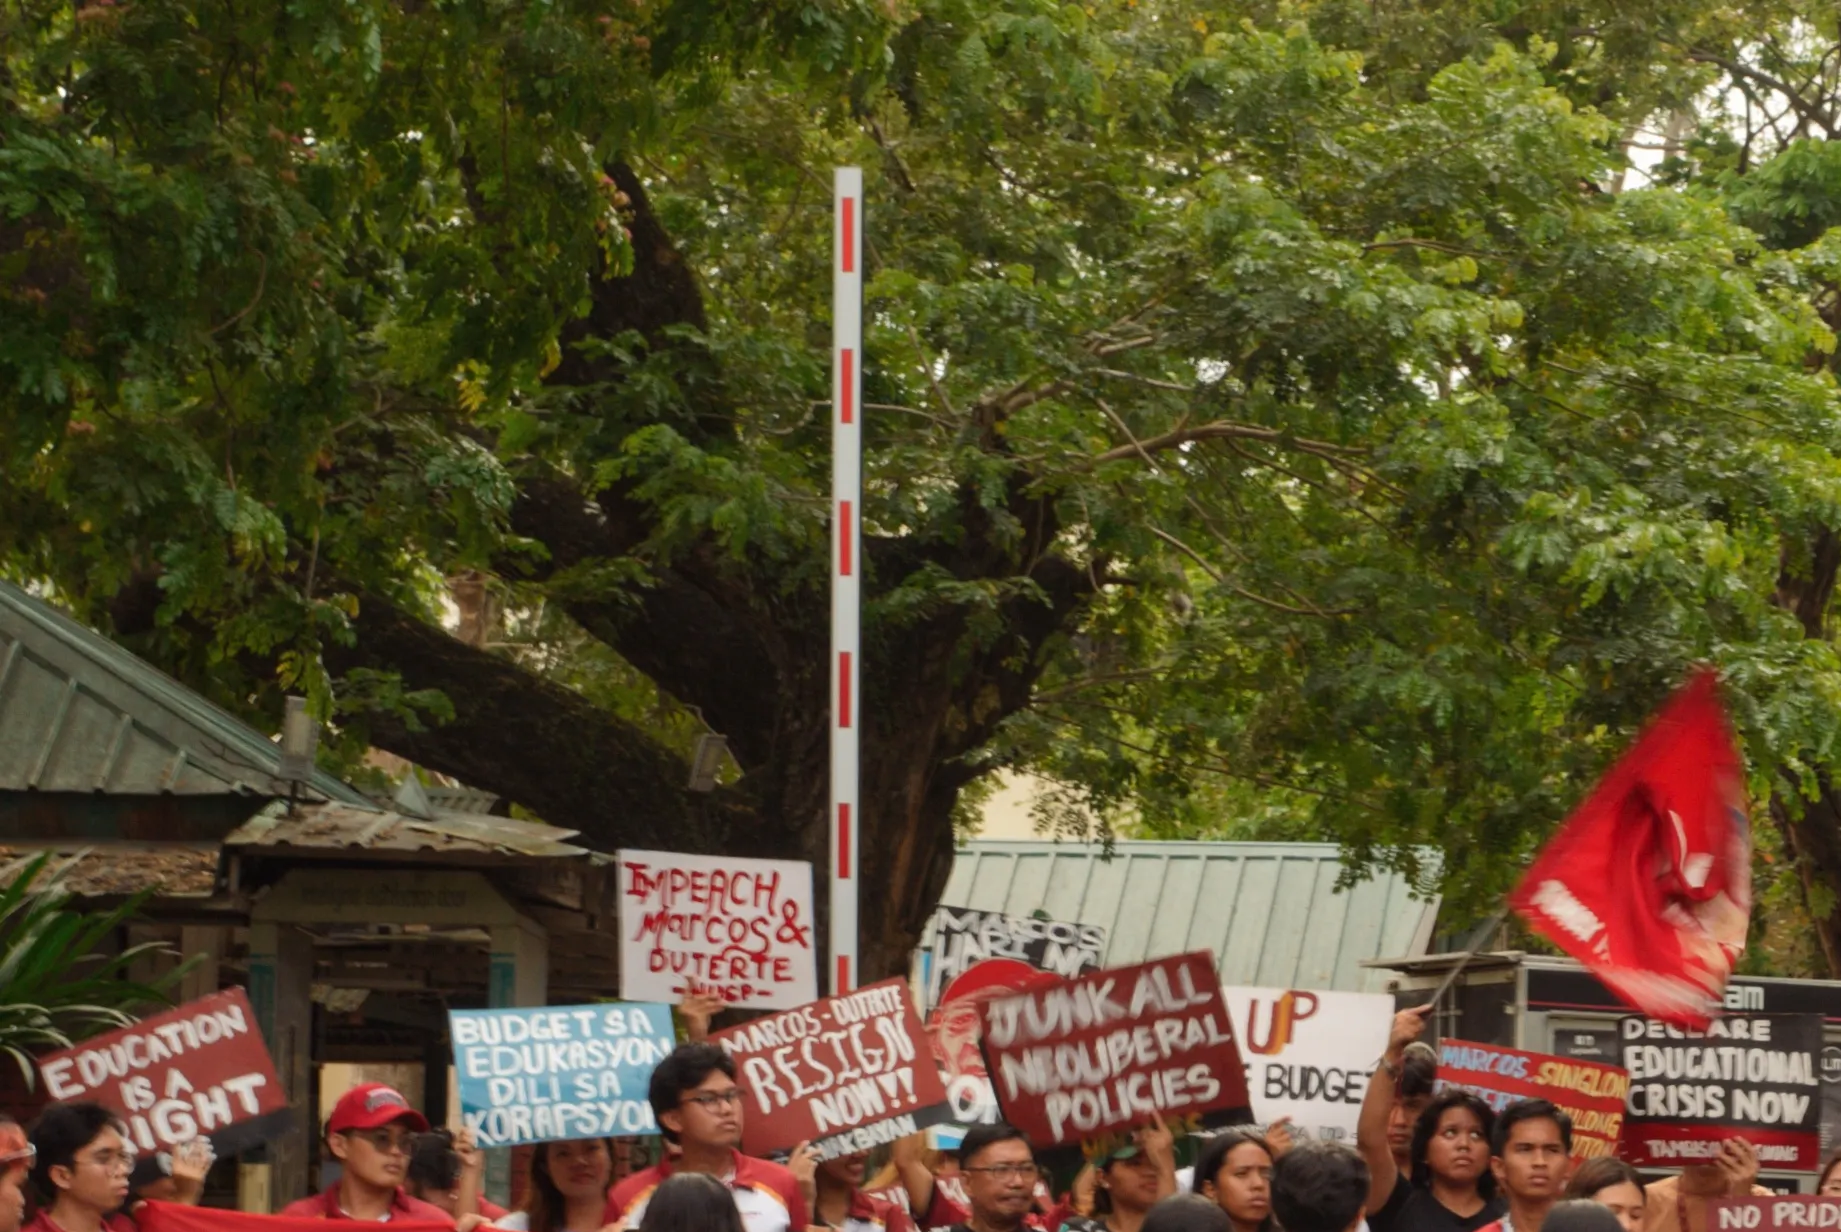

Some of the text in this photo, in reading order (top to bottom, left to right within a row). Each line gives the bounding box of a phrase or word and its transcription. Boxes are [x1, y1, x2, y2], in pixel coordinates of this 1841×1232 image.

[625, 862, 780, 917] IMPEACH
[648, 948, 795, 983] DUTERTE
[452, 1008, 655, 1045] BUDGET SA
[986, 963, 1214, 1048] JUNK ALL
[1246, 990, 1319, 1055] UP
[40, 1004, 248, 1100] EDUCATION
[465, 1037, 672, 1078] EDUKASYON
[743, 1011, 916, 1115] RESIGN
[1000, 1013, 1231, 1102] NEOLIBERAL
[1623, 1045, 1819, 1086] EDUCATIONAL
[119, 1067, 194, 1111] IS A
[488, 1071, 623, 1106] DILI SA
[1045, 1063, 1221, 1142] POLICIES
[1626, 1084, 1811, 1124] CRISIS NOW
[1718, 1204, 1761, 1230] NO
